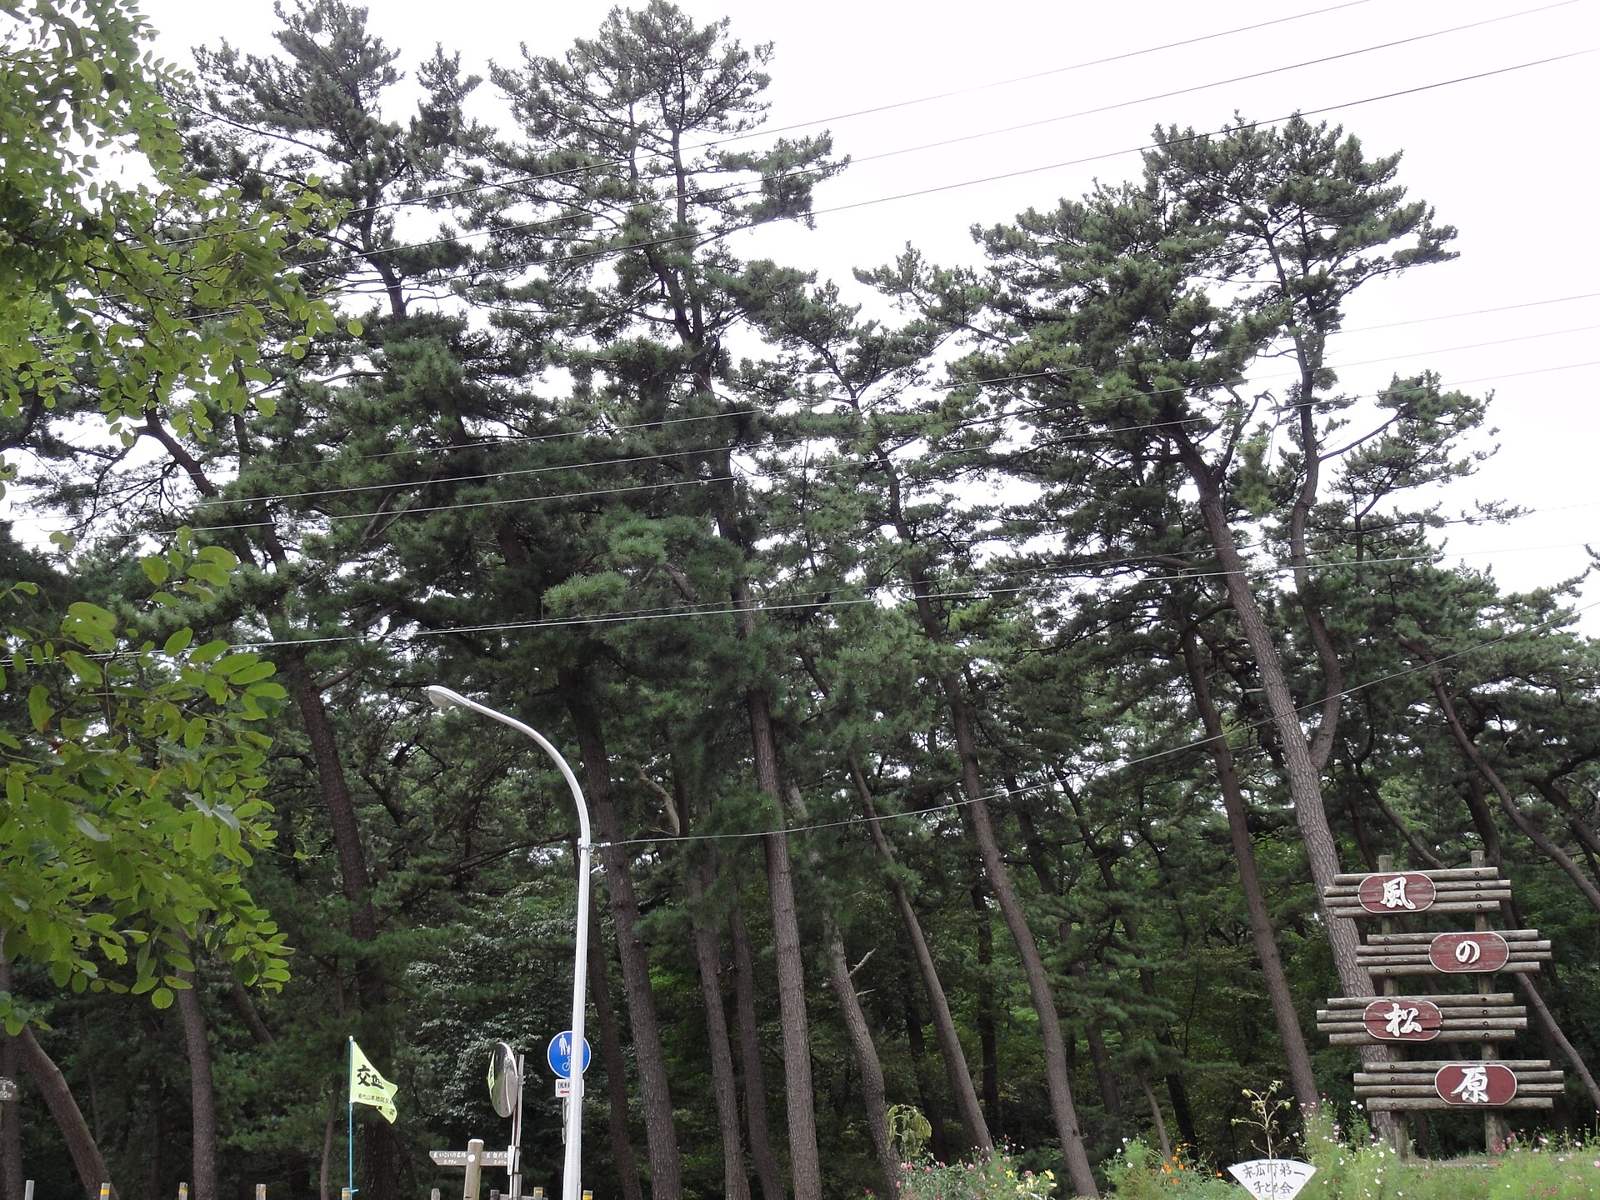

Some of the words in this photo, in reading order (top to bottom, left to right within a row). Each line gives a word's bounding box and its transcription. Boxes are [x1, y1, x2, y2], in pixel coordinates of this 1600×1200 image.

[1380, 875, 1416, 910] 風
[1455, 940, 1481, 964] の
[1383, 1003, 1423, 1037] 松
[1450, 1066, 1489, 1103] 原
